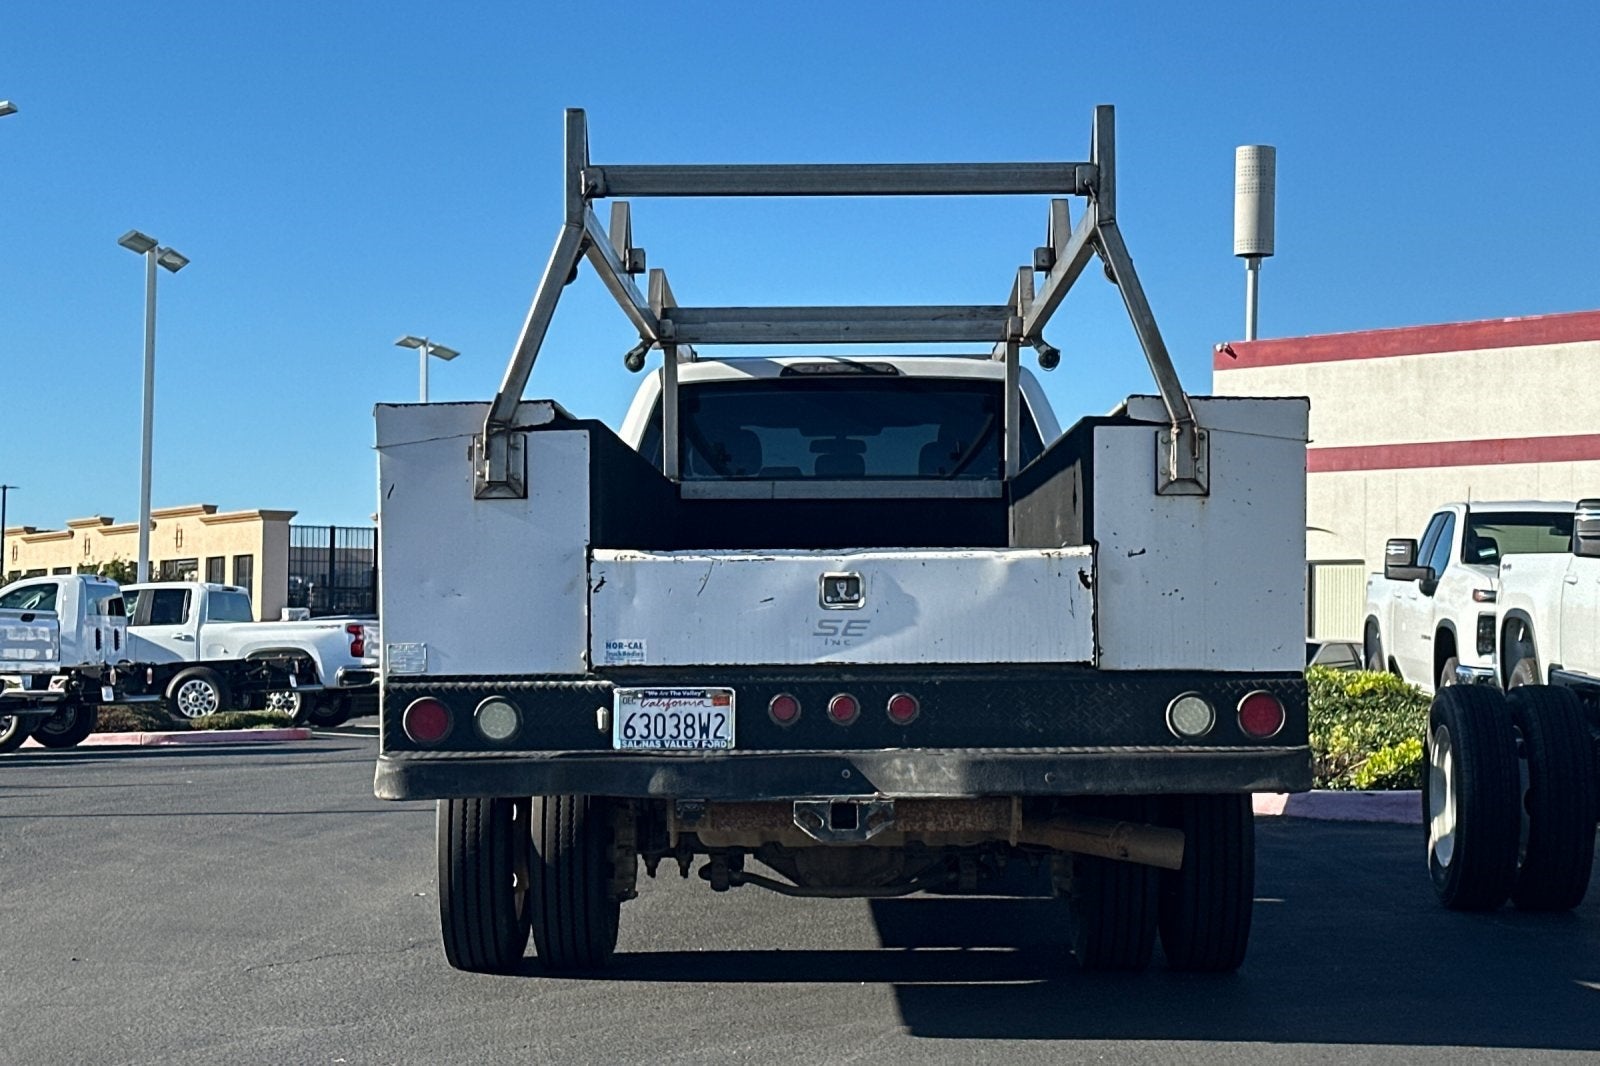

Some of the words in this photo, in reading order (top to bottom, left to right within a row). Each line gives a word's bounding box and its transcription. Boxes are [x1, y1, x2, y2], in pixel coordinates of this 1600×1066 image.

[813, 620, 871, 636] SE
[640, 697, 711, 712] California
[623, 712, 726, 740] 63038W2
